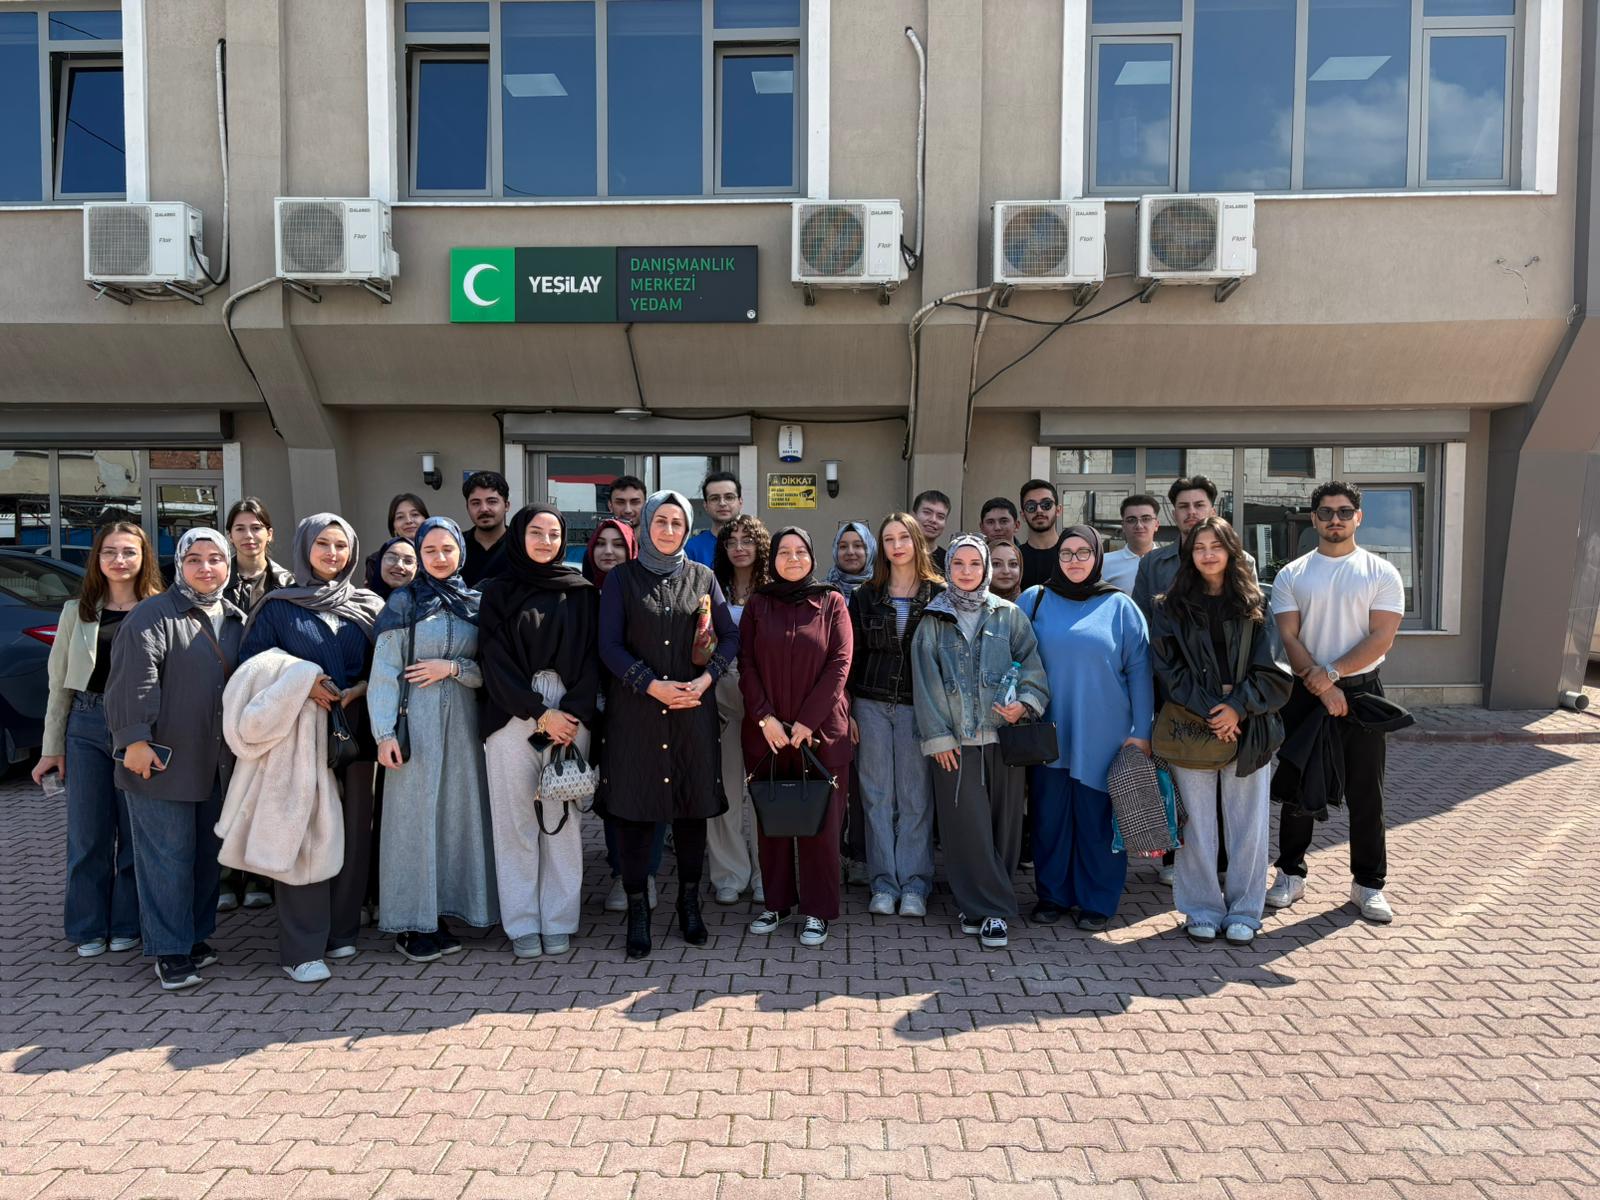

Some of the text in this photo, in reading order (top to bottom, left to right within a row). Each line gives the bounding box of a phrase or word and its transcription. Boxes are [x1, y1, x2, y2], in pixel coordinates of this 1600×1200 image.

[630, 257, 735, 275] DANIŞMANLIK
[630, 274, 696, 291] MERKEZİ
[630, 297, 682, 311] YEDAM
[781, 476, 813, 485] DİKKAT
